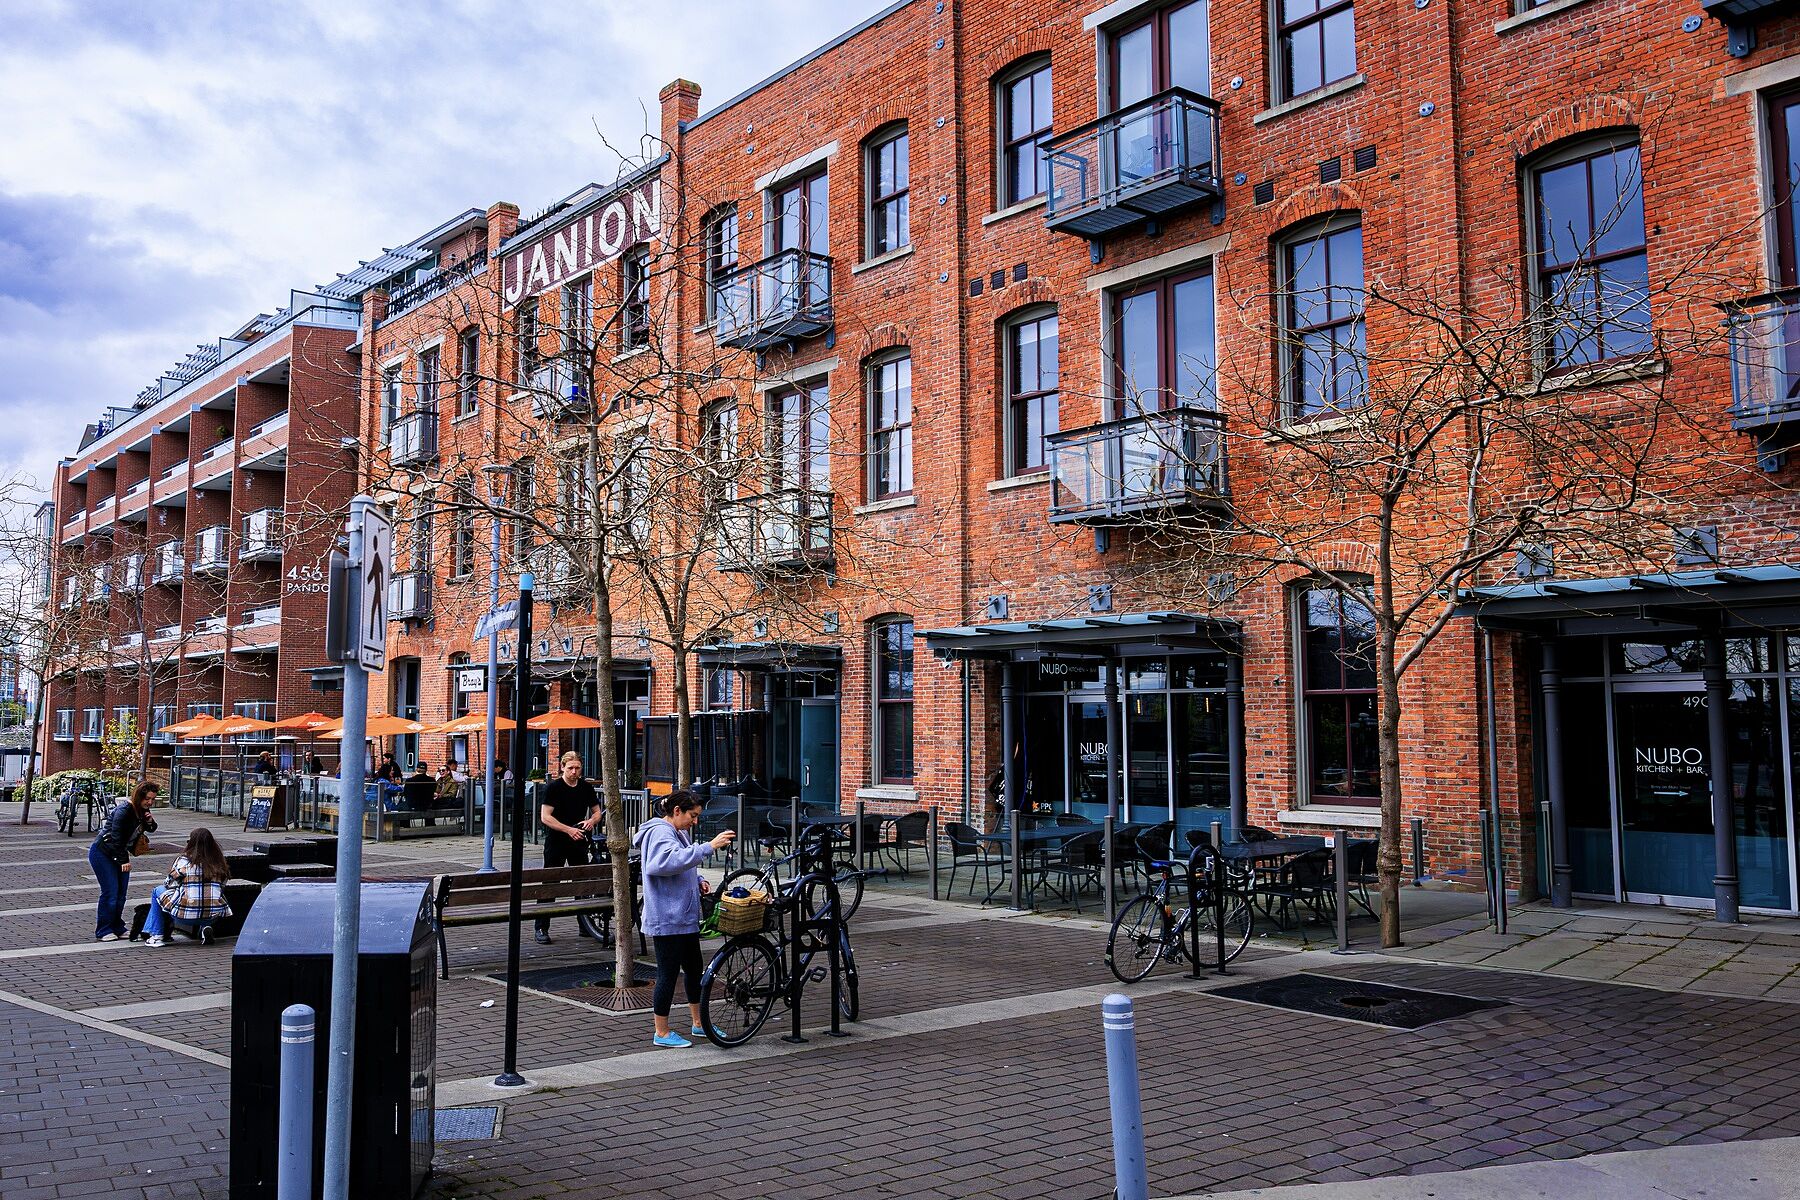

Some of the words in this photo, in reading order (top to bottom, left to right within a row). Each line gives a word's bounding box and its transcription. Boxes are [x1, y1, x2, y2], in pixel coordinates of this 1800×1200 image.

[505, 179, 661, 303] JANION
[286, 565, 323, 581] 456
[1041, 663, 1068, 675] NUBO
[461, 674, 482, 688] Bray's
[1635, 747, 1702, 764] NUBO
[1636, 765, 1673, 773] KITCHEN
[1686, 766, 1704, 775] BAR
